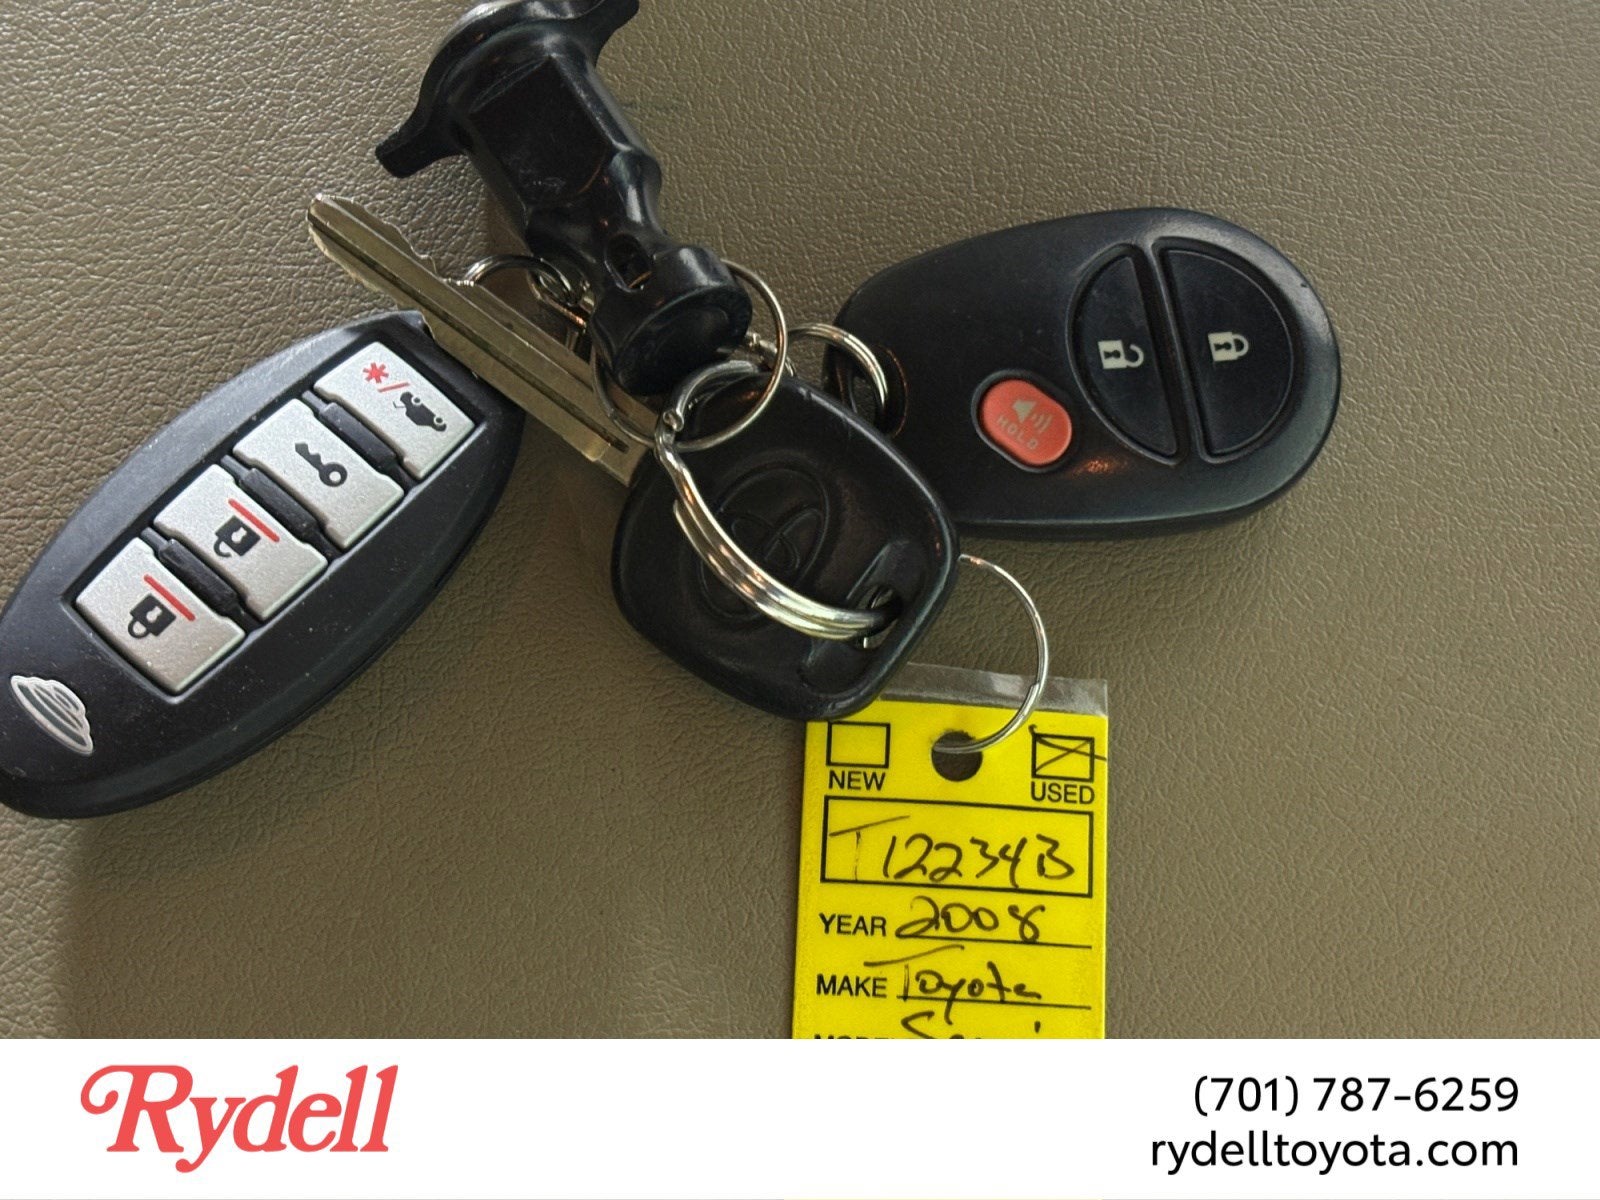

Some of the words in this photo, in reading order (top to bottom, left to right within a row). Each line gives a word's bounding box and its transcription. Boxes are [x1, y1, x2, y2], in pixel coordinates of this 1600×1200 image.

[828, 770, 886, 792] NEW
[1030, 781, 1095, 805] USED
[829, 815, 1075, 889] T12234B
[819, 912, 887, 937] YEAR
[895, 895, 1046, 944] 2008
[816, 973, 888, 999] MAKE
[863, 943, 1042, 1026] Toyota
